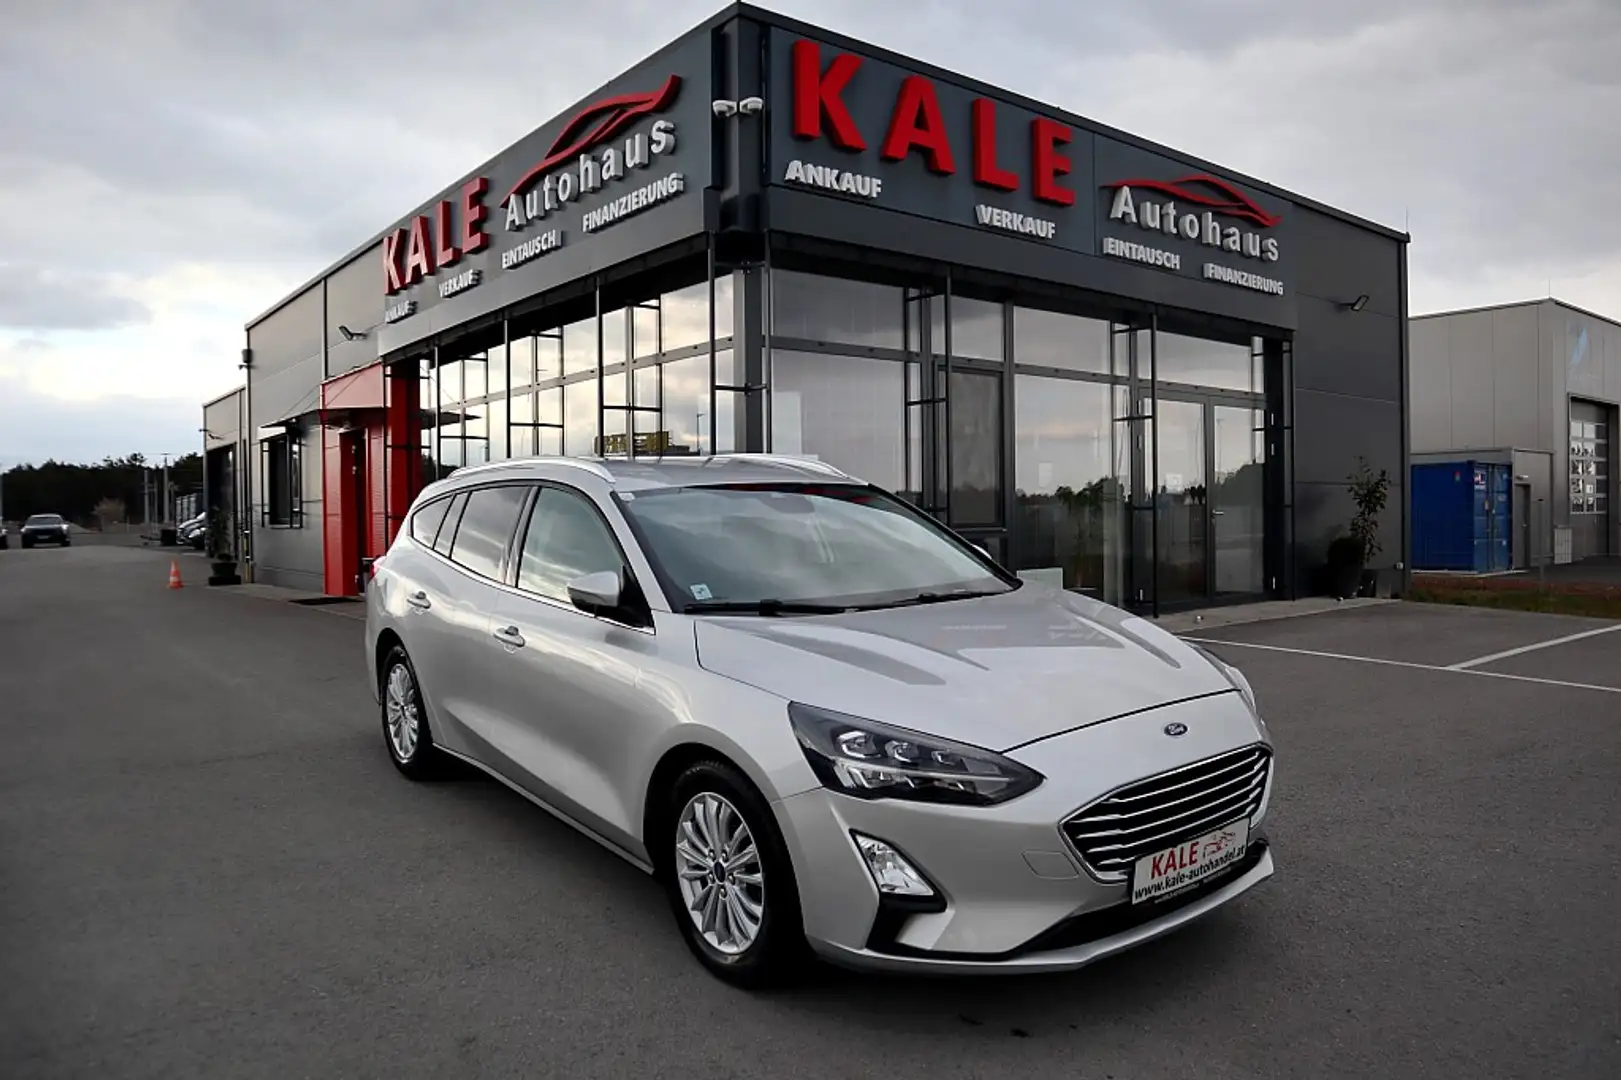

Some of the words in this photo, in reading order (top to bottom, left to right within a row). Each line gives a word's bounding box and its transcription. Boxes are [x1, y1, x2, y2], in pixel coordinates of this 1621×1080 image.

[382, 178, 488, 295] KALE
[505, 120, 675, 231] Autohaus
[793, 40, 1075, 206] KALE
[1111, 185, 1279, 261] Autohaus
[439, 269, 482, 298] VERKAUF
[502, 230, 561, 268] EINTAUSCH
[582, 173, 683, 231] FINANZIERUNG
[785, 160, 881, 198] ANKAUF
[975, 204, 1056, 239] VERKAUF
[1103, 237, 1180, 270] EINTAUSCH
[1203, 263, 1283, 295] FINANZIERUNG
[1135, 845, 1245, 900] www.kale-autohandel.at
[1150, 841, 1200, 879] KALE
